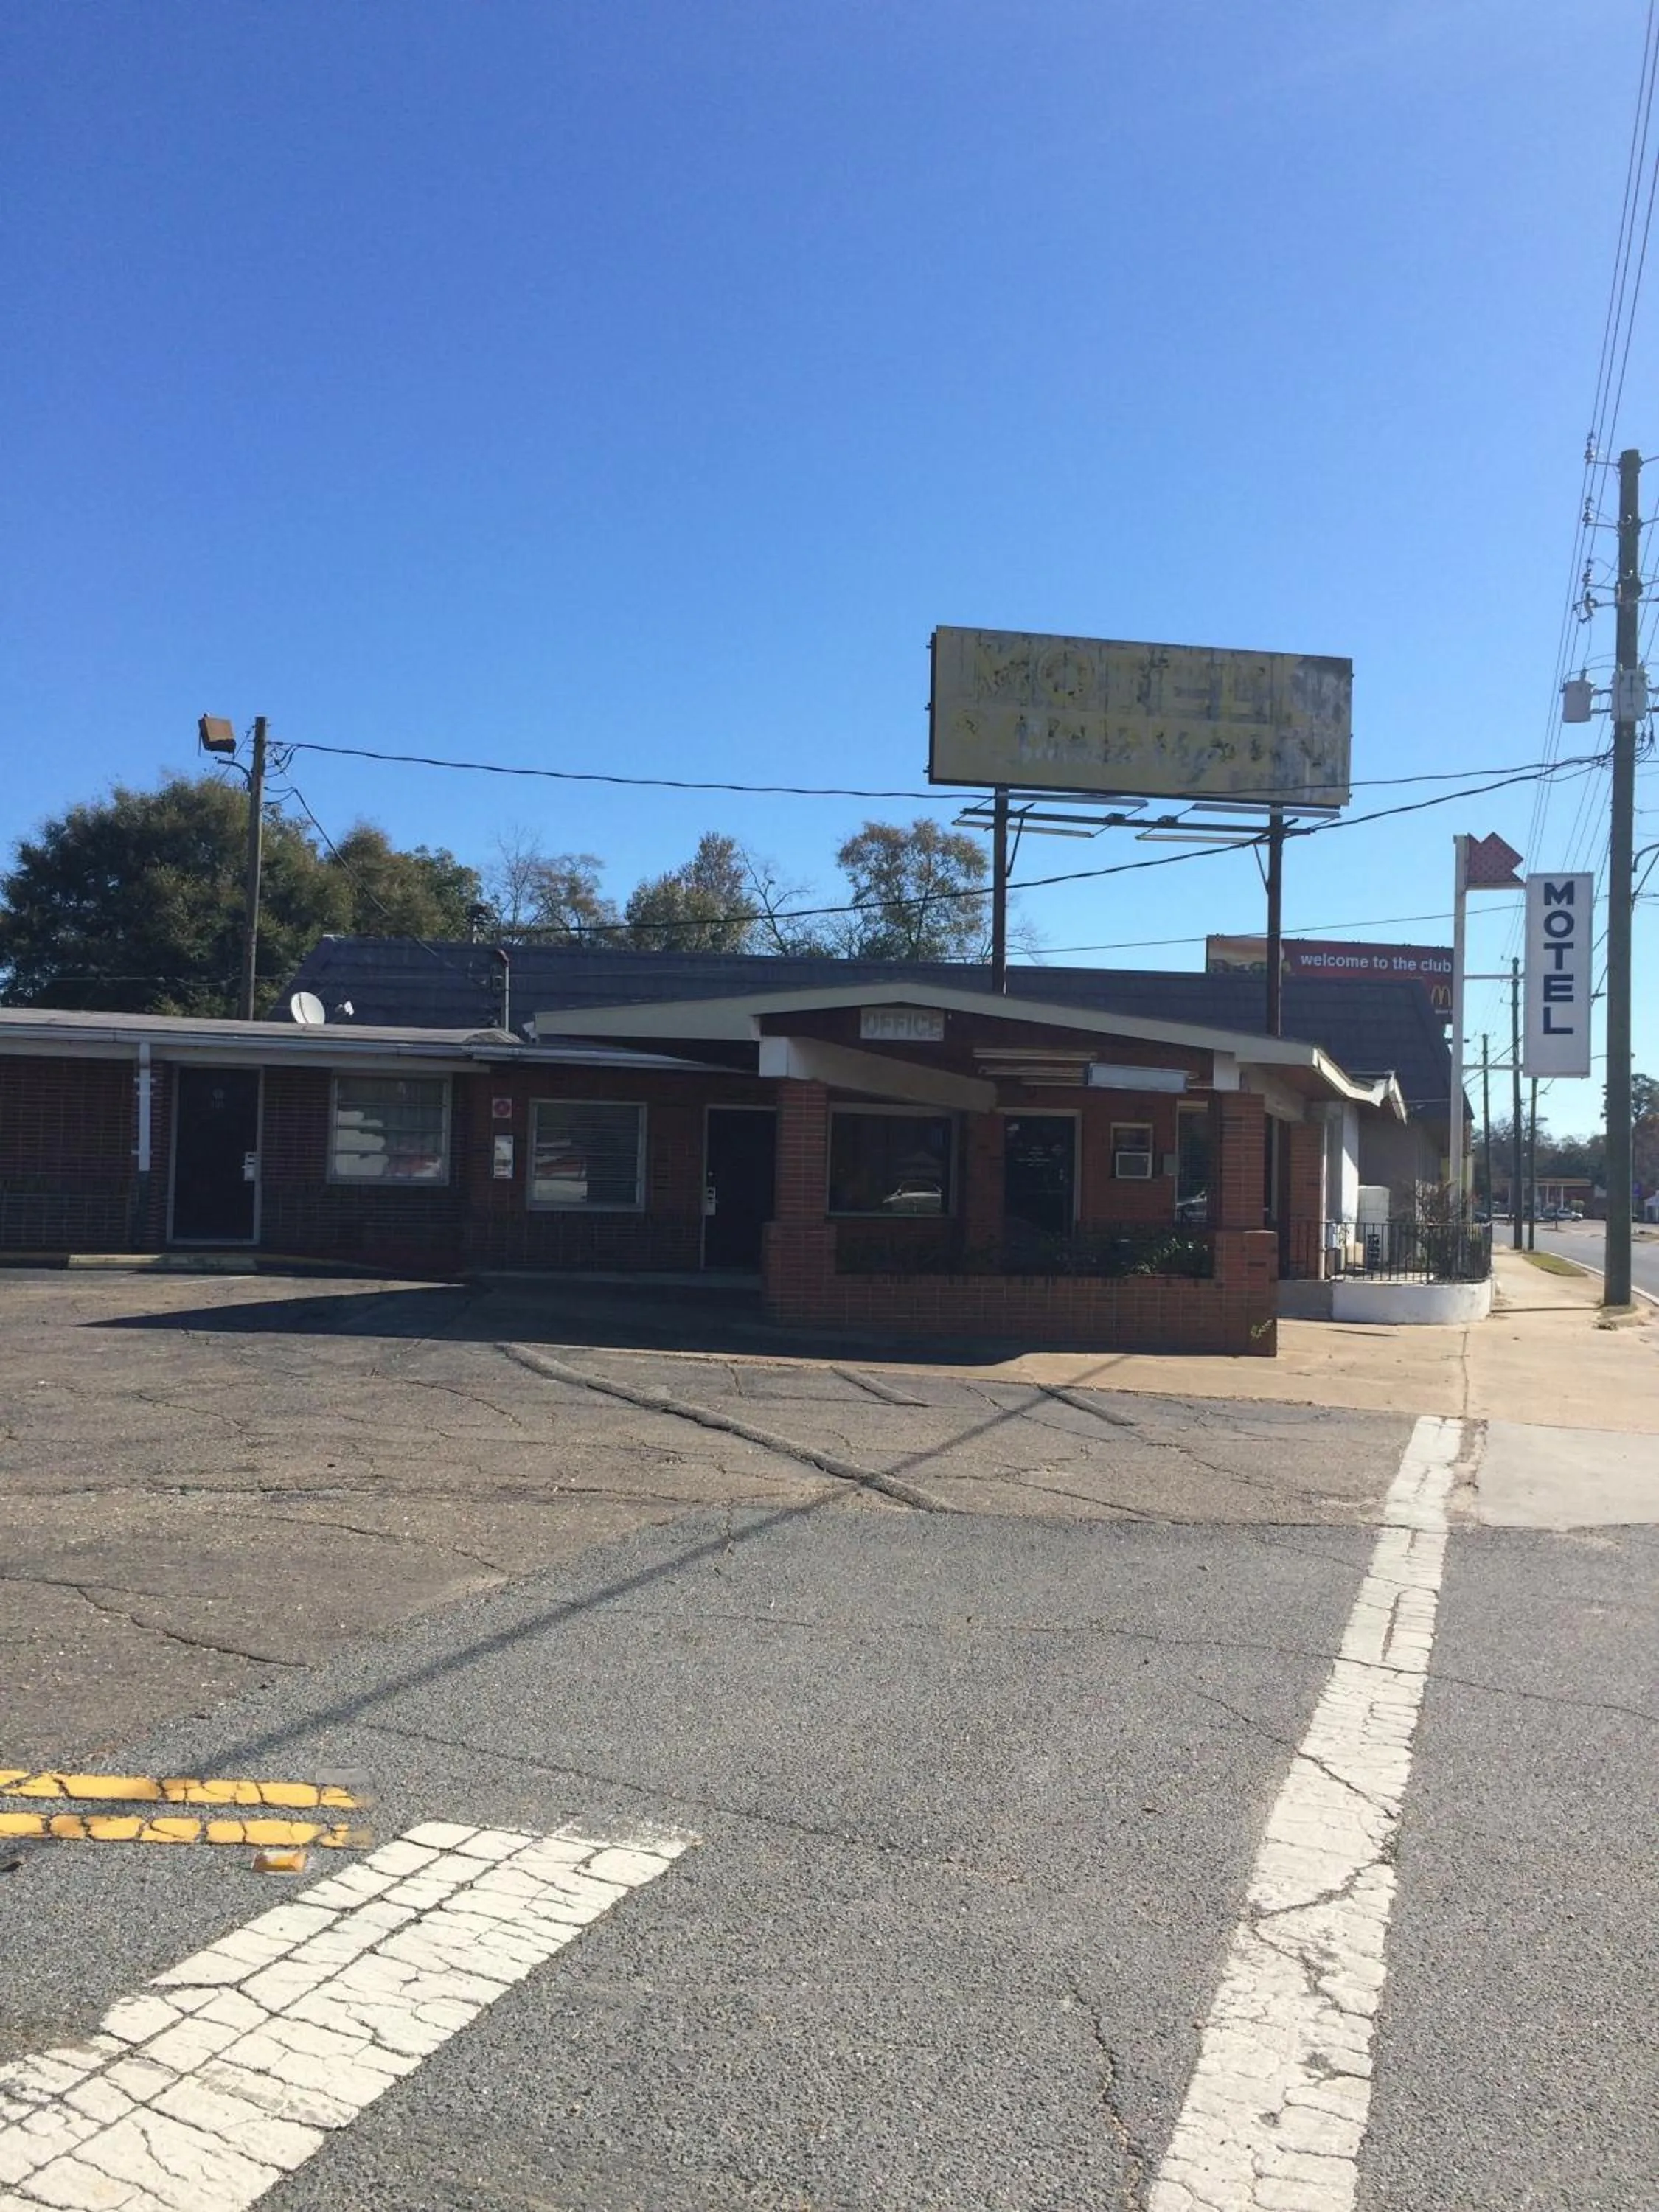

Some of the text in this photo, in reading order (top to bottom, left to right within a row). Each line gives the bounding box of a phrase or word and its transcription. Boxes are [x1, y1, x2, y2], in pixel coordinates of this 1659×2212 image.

[1301, 953, 1452, 973] welcome to the club
[1543, 880, 1574, 1035] MOTEL
[862, 1012, 943, 1038] OFFICE
